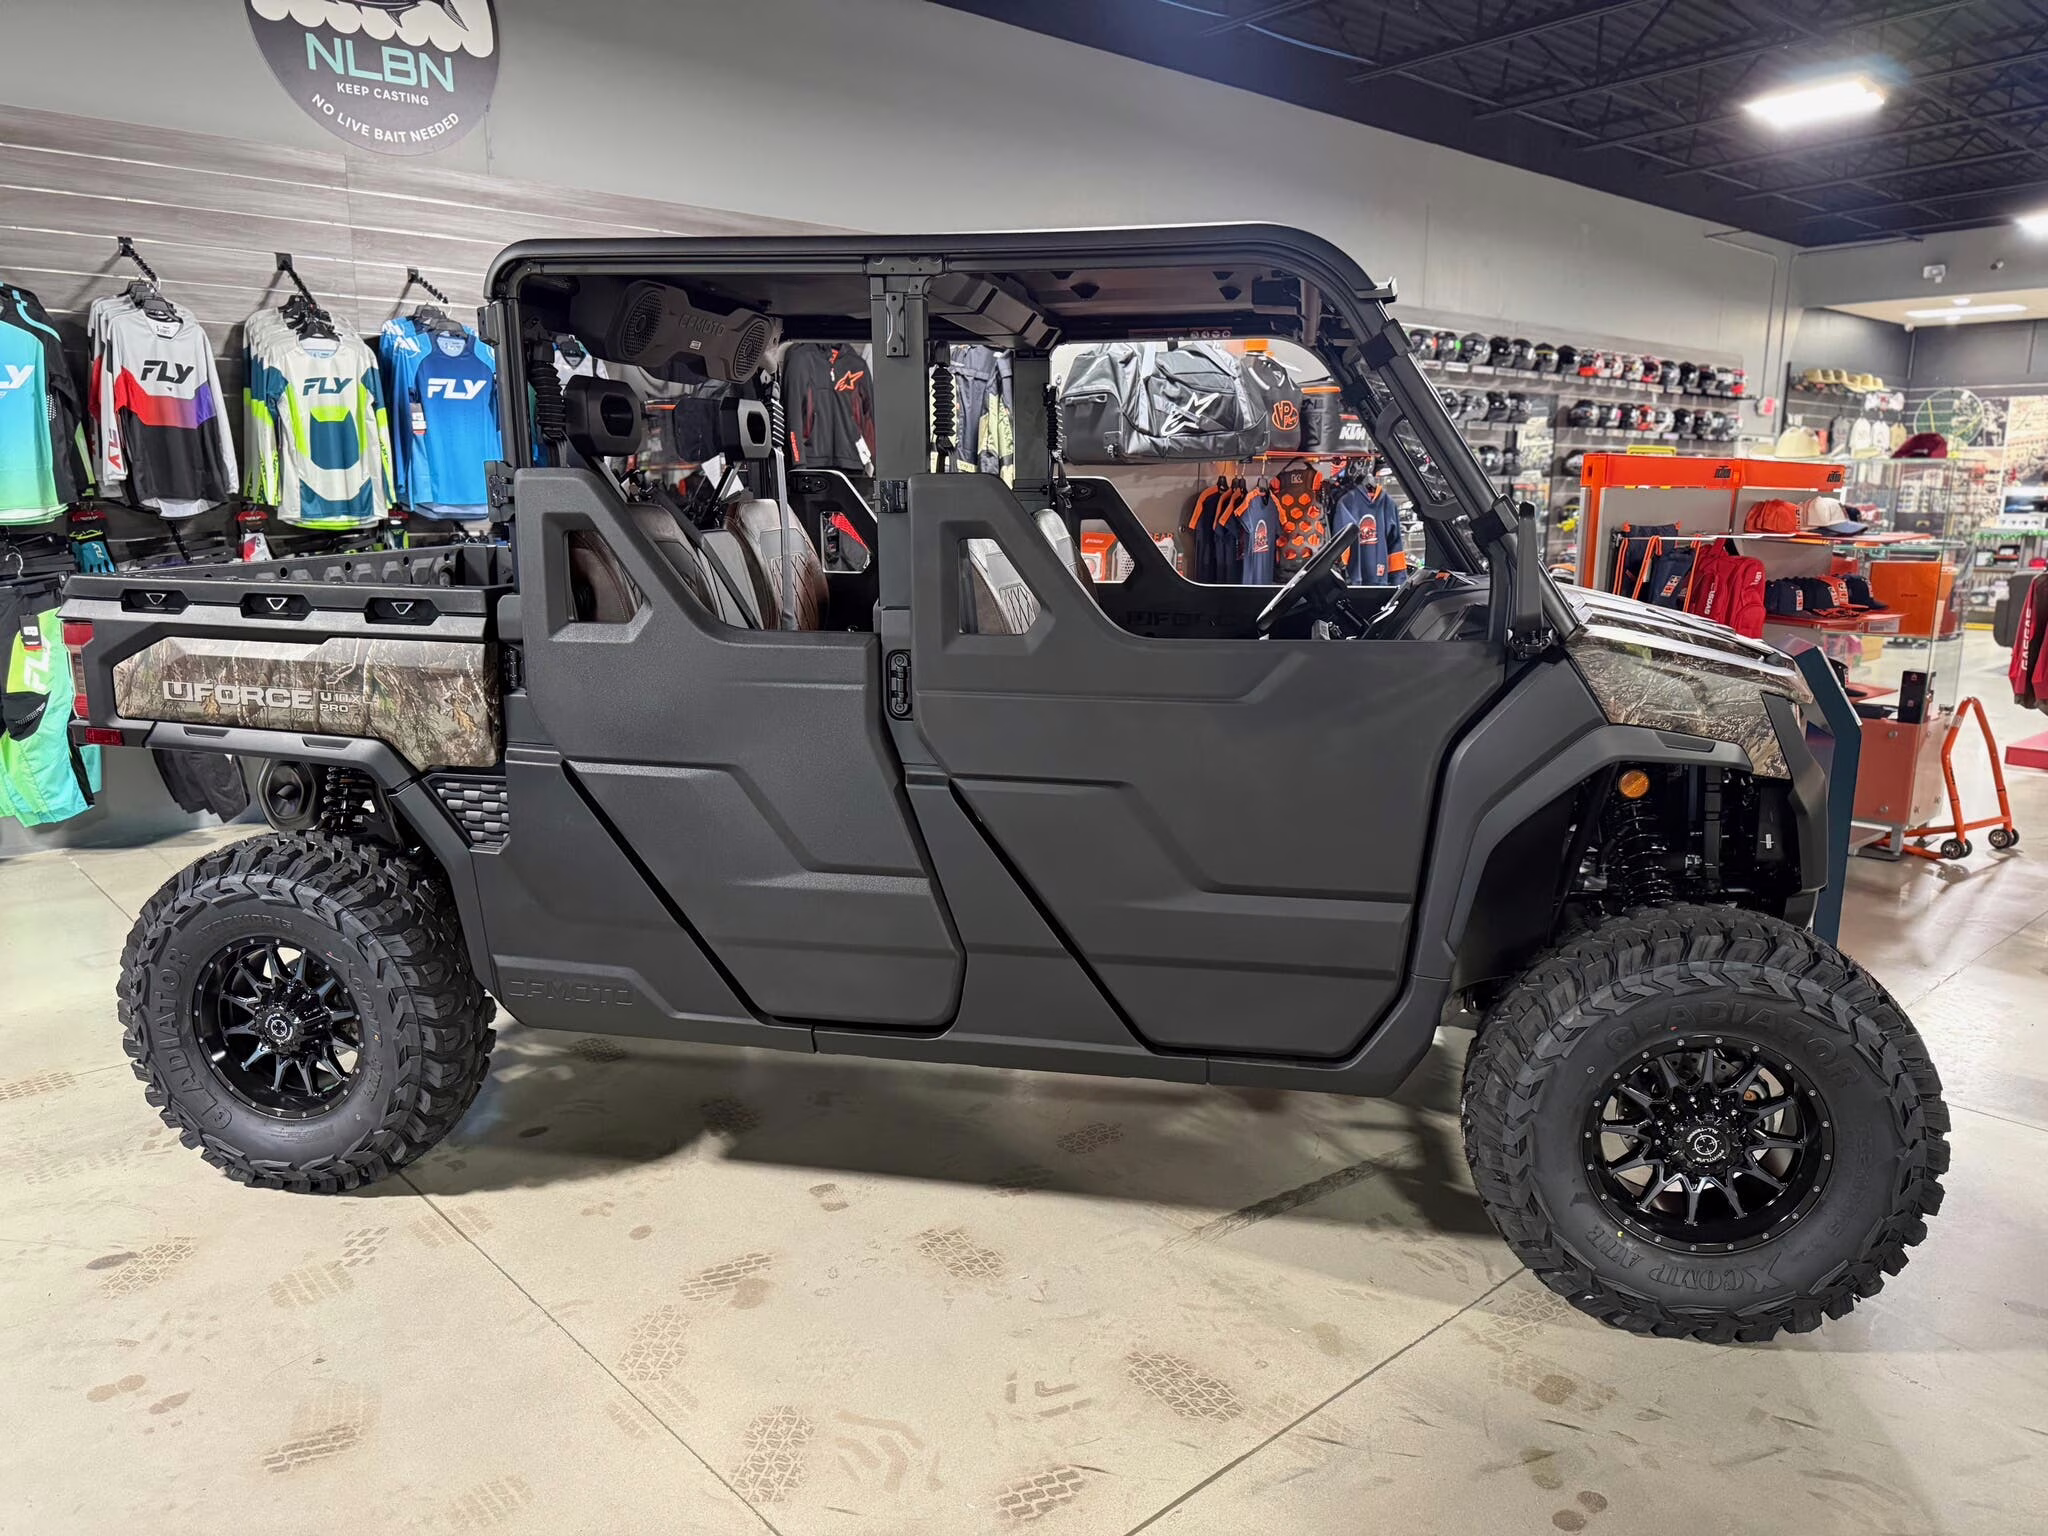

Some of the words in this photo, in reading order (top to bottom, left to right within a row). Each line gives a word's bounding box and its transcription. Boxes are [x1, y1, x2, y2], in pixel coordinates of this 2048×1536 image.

[305, 32, 454, 93] NLBN
[336, 82, 369, 96] KEEP
[374, 88, 429, 106] CASTING
[311, 94, 335, 116] NO
[337, 112, 370, 137] LIVE
[374, 127, 408, 144] BAIT
[409, 112, 460, 143] NEEDED
[140, 360, 194, 384] FLY
[303, 377, 353, 396] FLY
[428, 377, 487, 400] FLY
[1339, 423, 1366, 440] KTM
[162, 681, 314, 710] UFORCE
[319, 703, 349, 713] PRO
